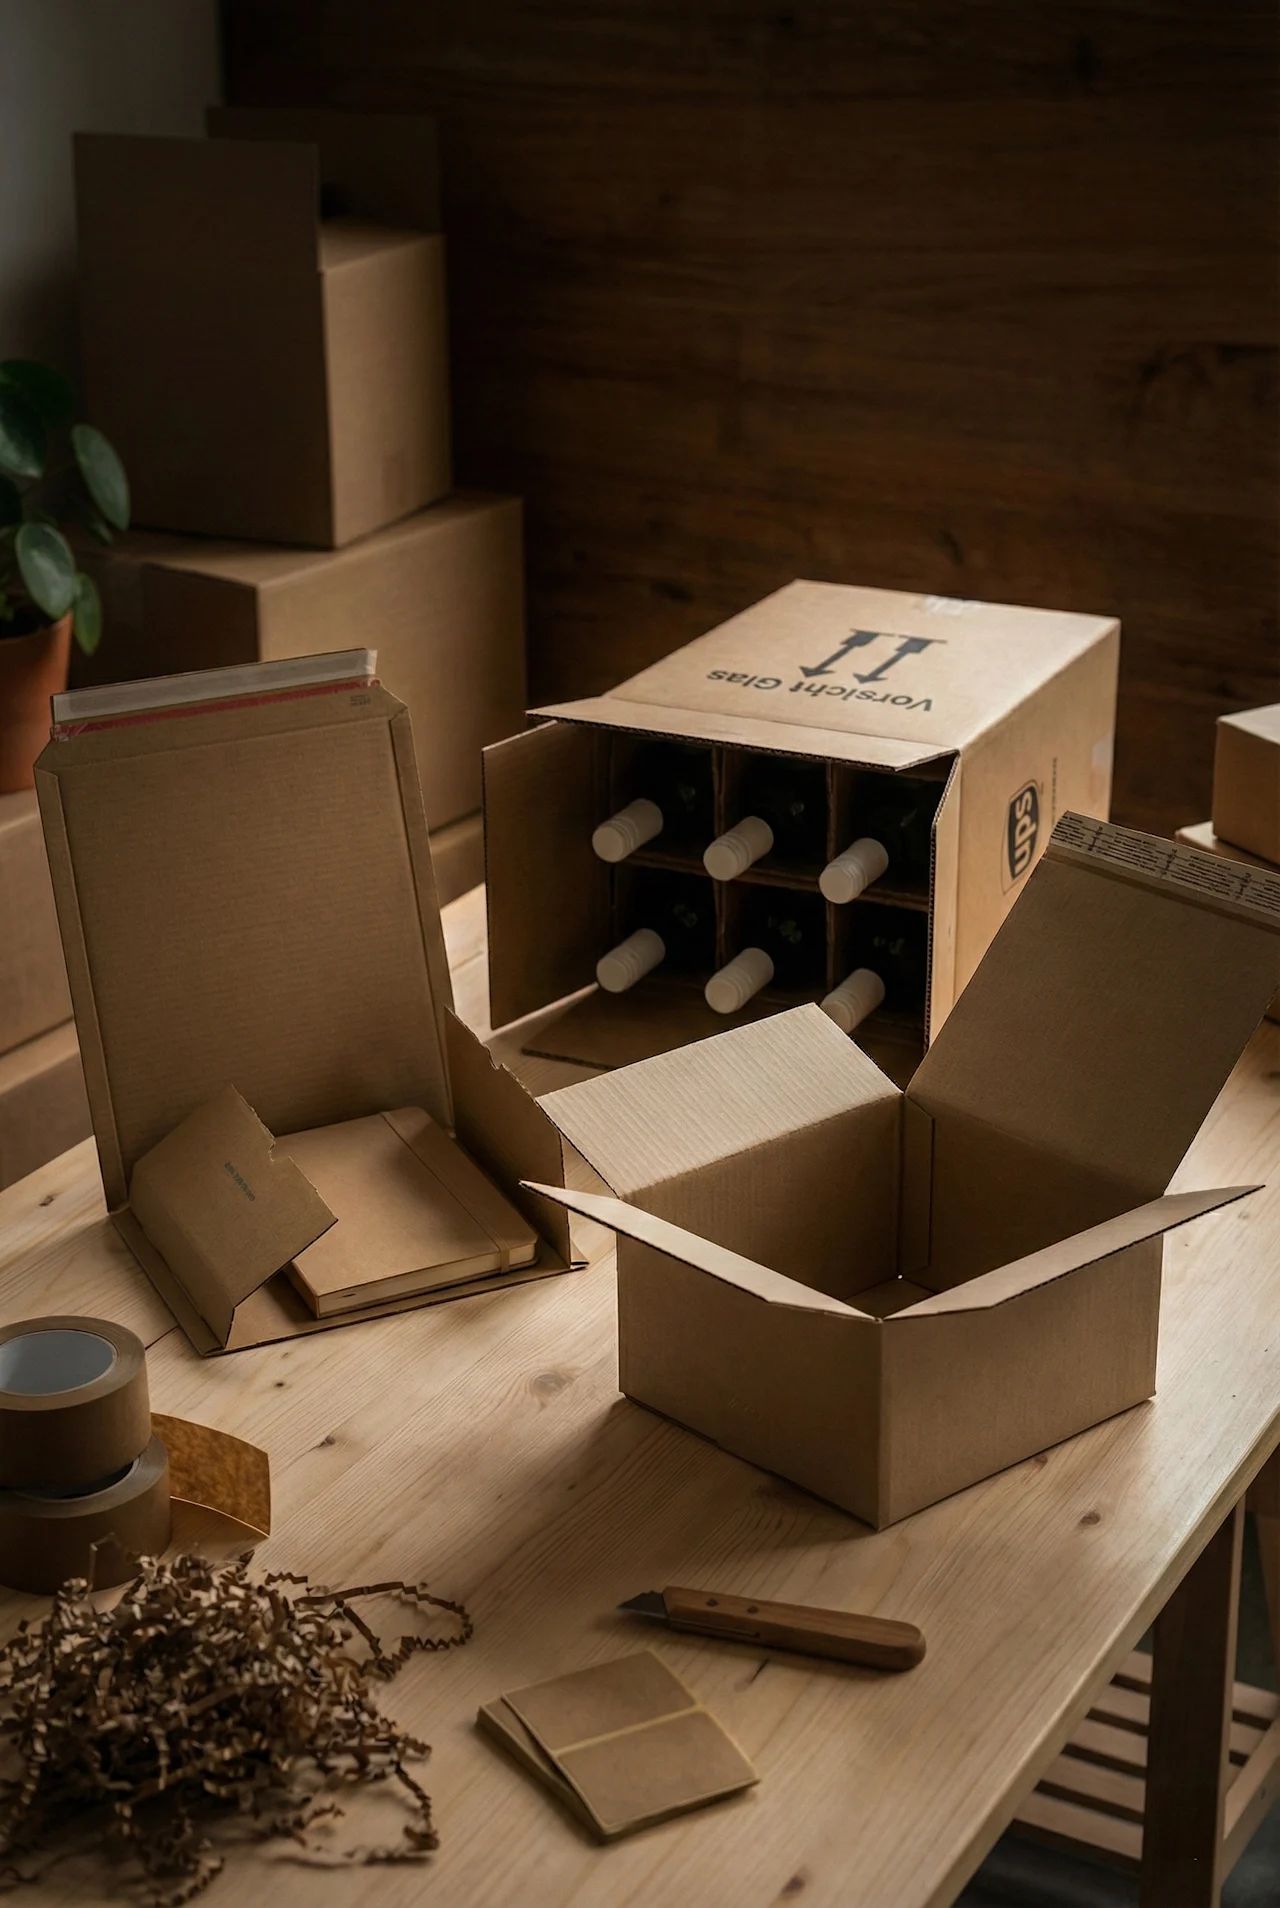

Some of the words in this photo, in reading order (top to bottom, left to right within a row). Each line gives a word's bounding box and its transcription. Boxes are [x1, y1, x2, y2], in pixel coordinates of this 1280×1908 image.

[706, 669, 782, 691] Glas
[789, 681, 934, 712] Vorsicht
[1014, 790, 1037, 876] ups
